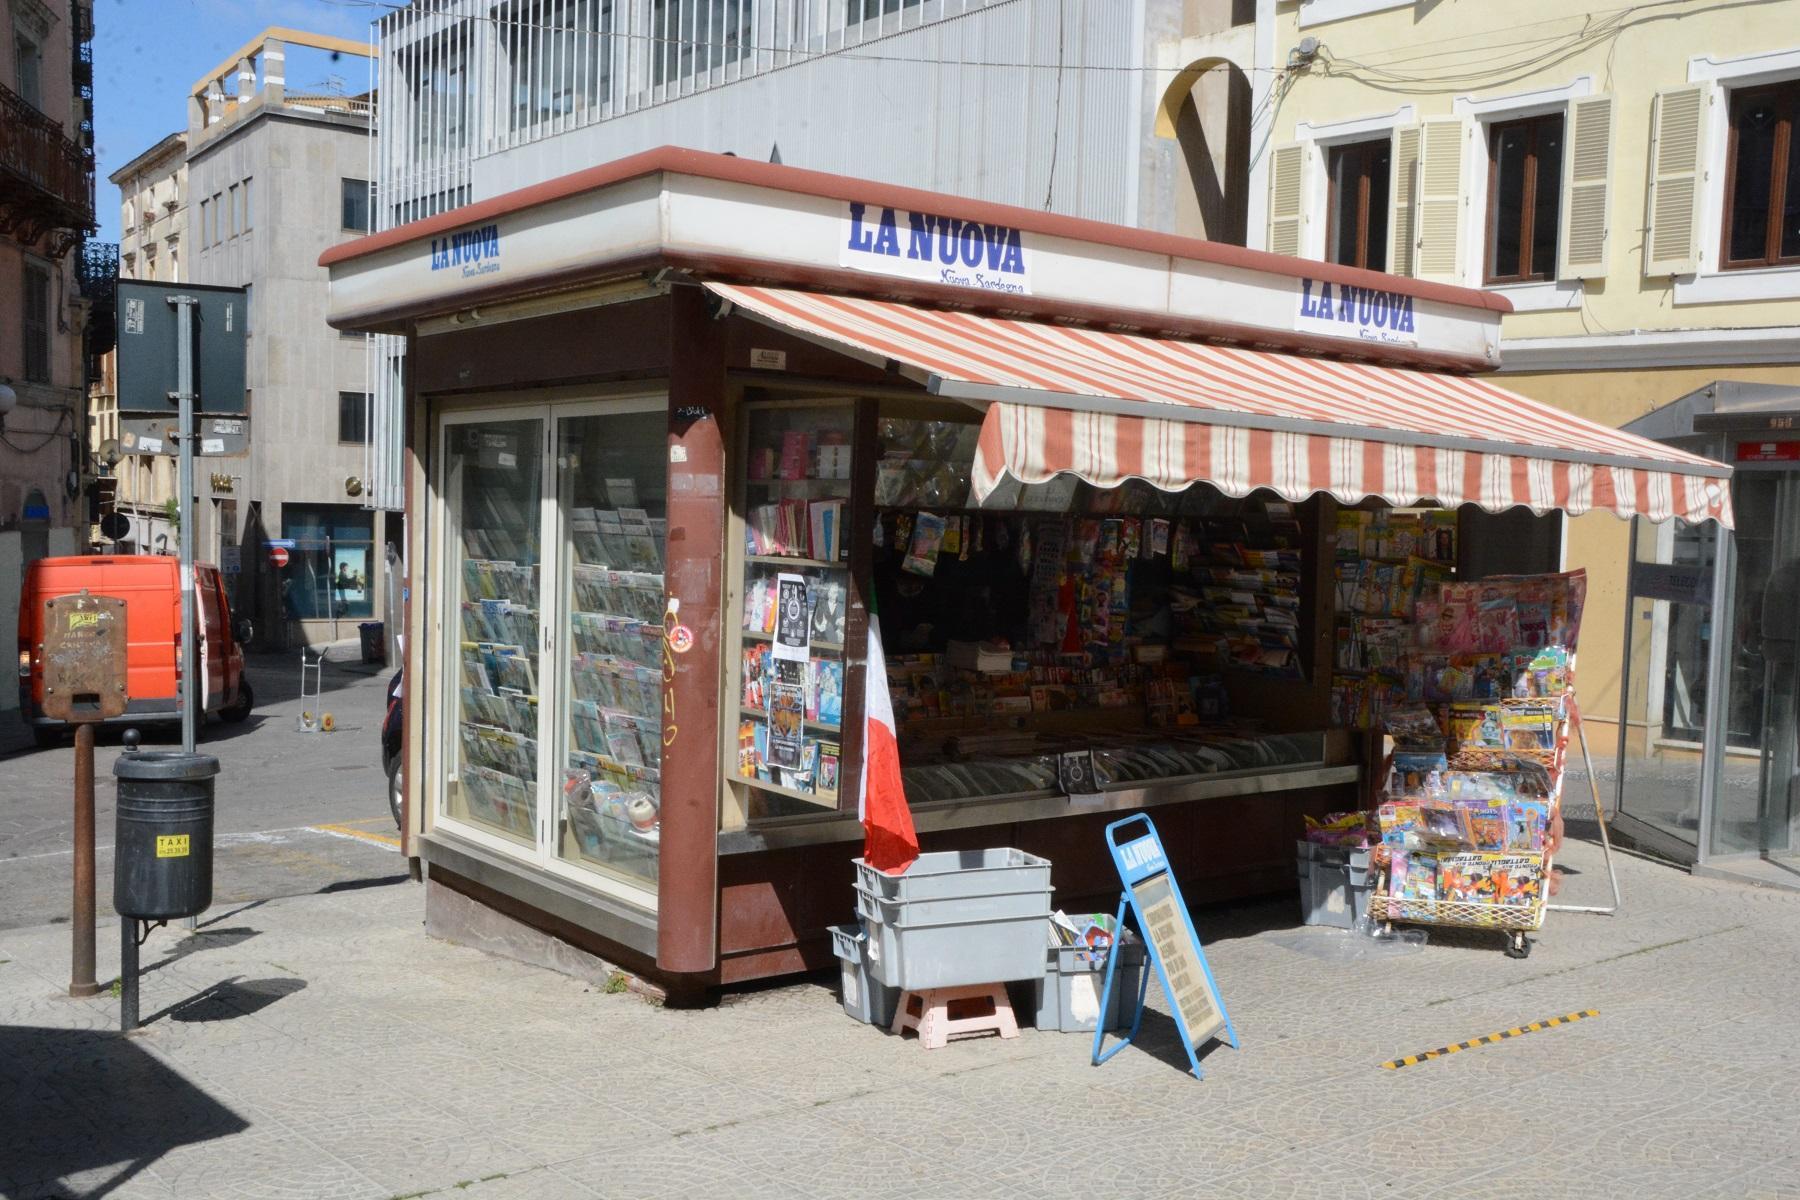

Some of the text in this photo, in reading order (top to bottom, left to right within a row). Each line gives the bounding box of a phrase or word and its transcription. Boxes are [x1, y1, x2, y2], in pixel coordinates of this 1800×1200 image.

[431, 224, 499, 271] LA NUOVA
[848, 202, 1025, 275] LA NUOVA
[1301, 278, 1415, 333] LA NUOVA
[160, 838, 187, 846] TAXI
